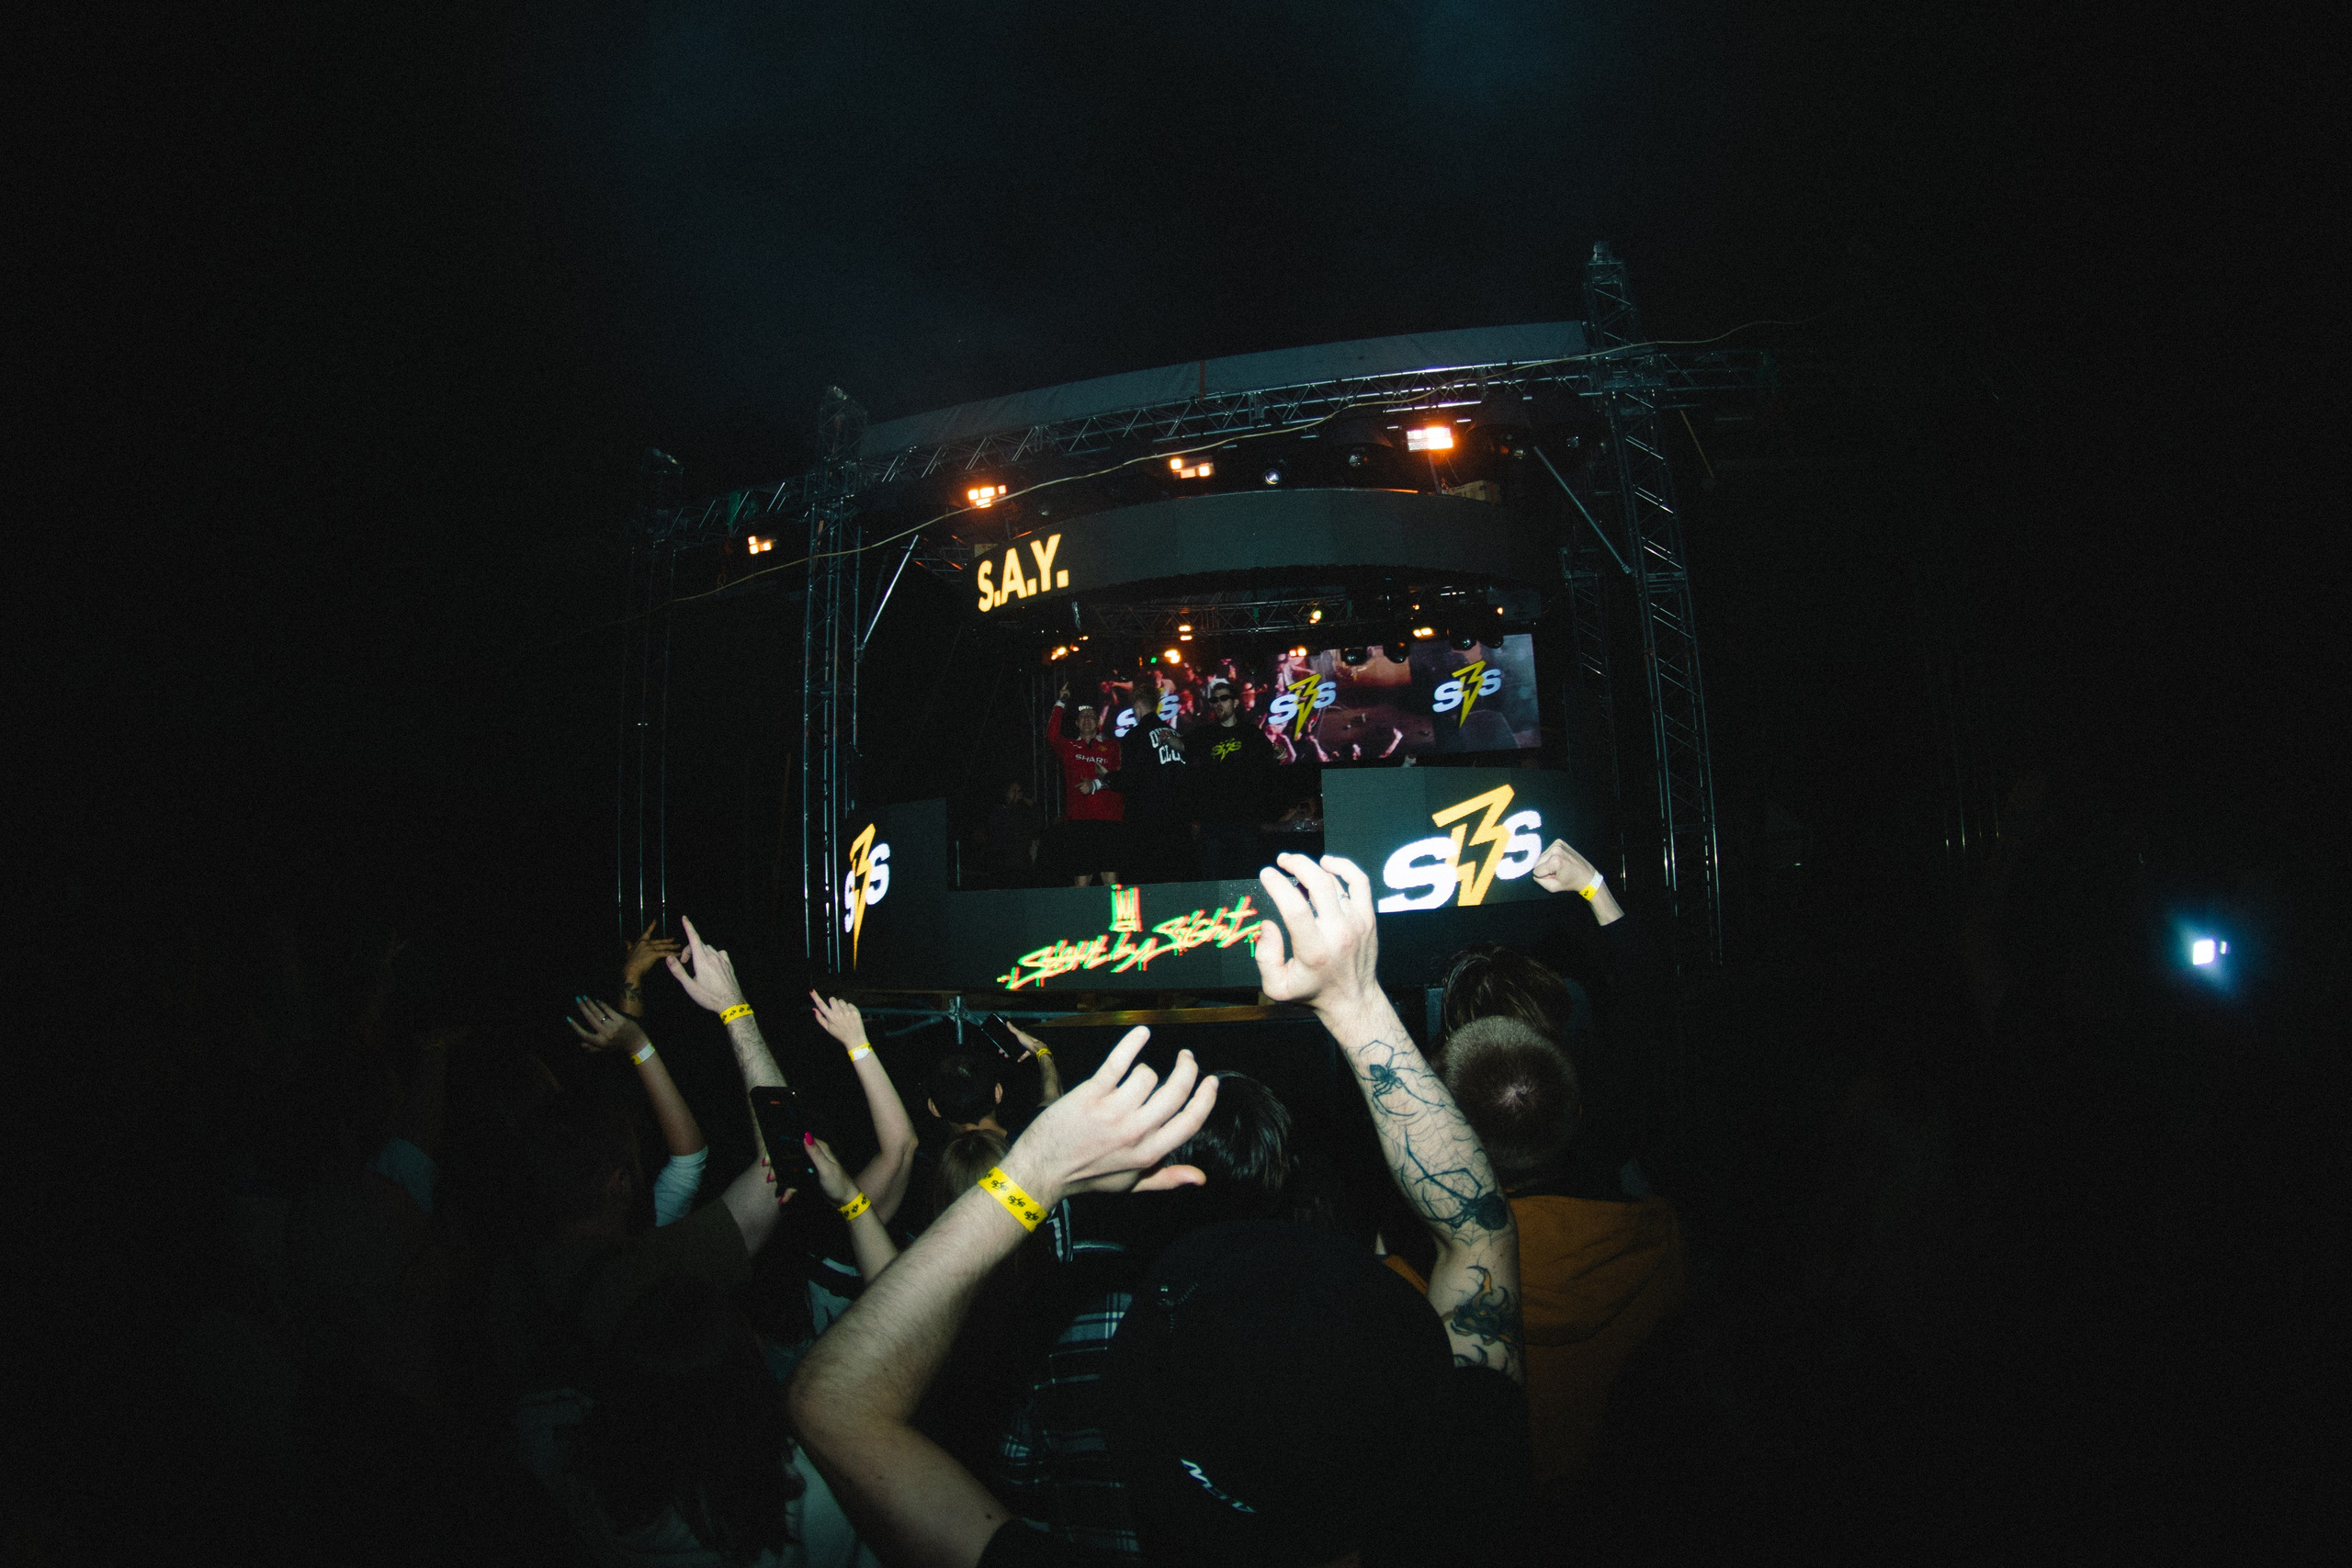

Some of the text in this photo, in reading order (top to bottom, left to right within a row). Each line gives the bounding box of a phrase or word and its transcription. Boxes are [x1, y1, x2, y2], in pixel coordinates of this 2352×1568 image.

[978, 534, 1069, 613] S.A.Y.
[1075, 753, 1108, 764] SHARP
[1159, 745, 1186, 765] CLU
